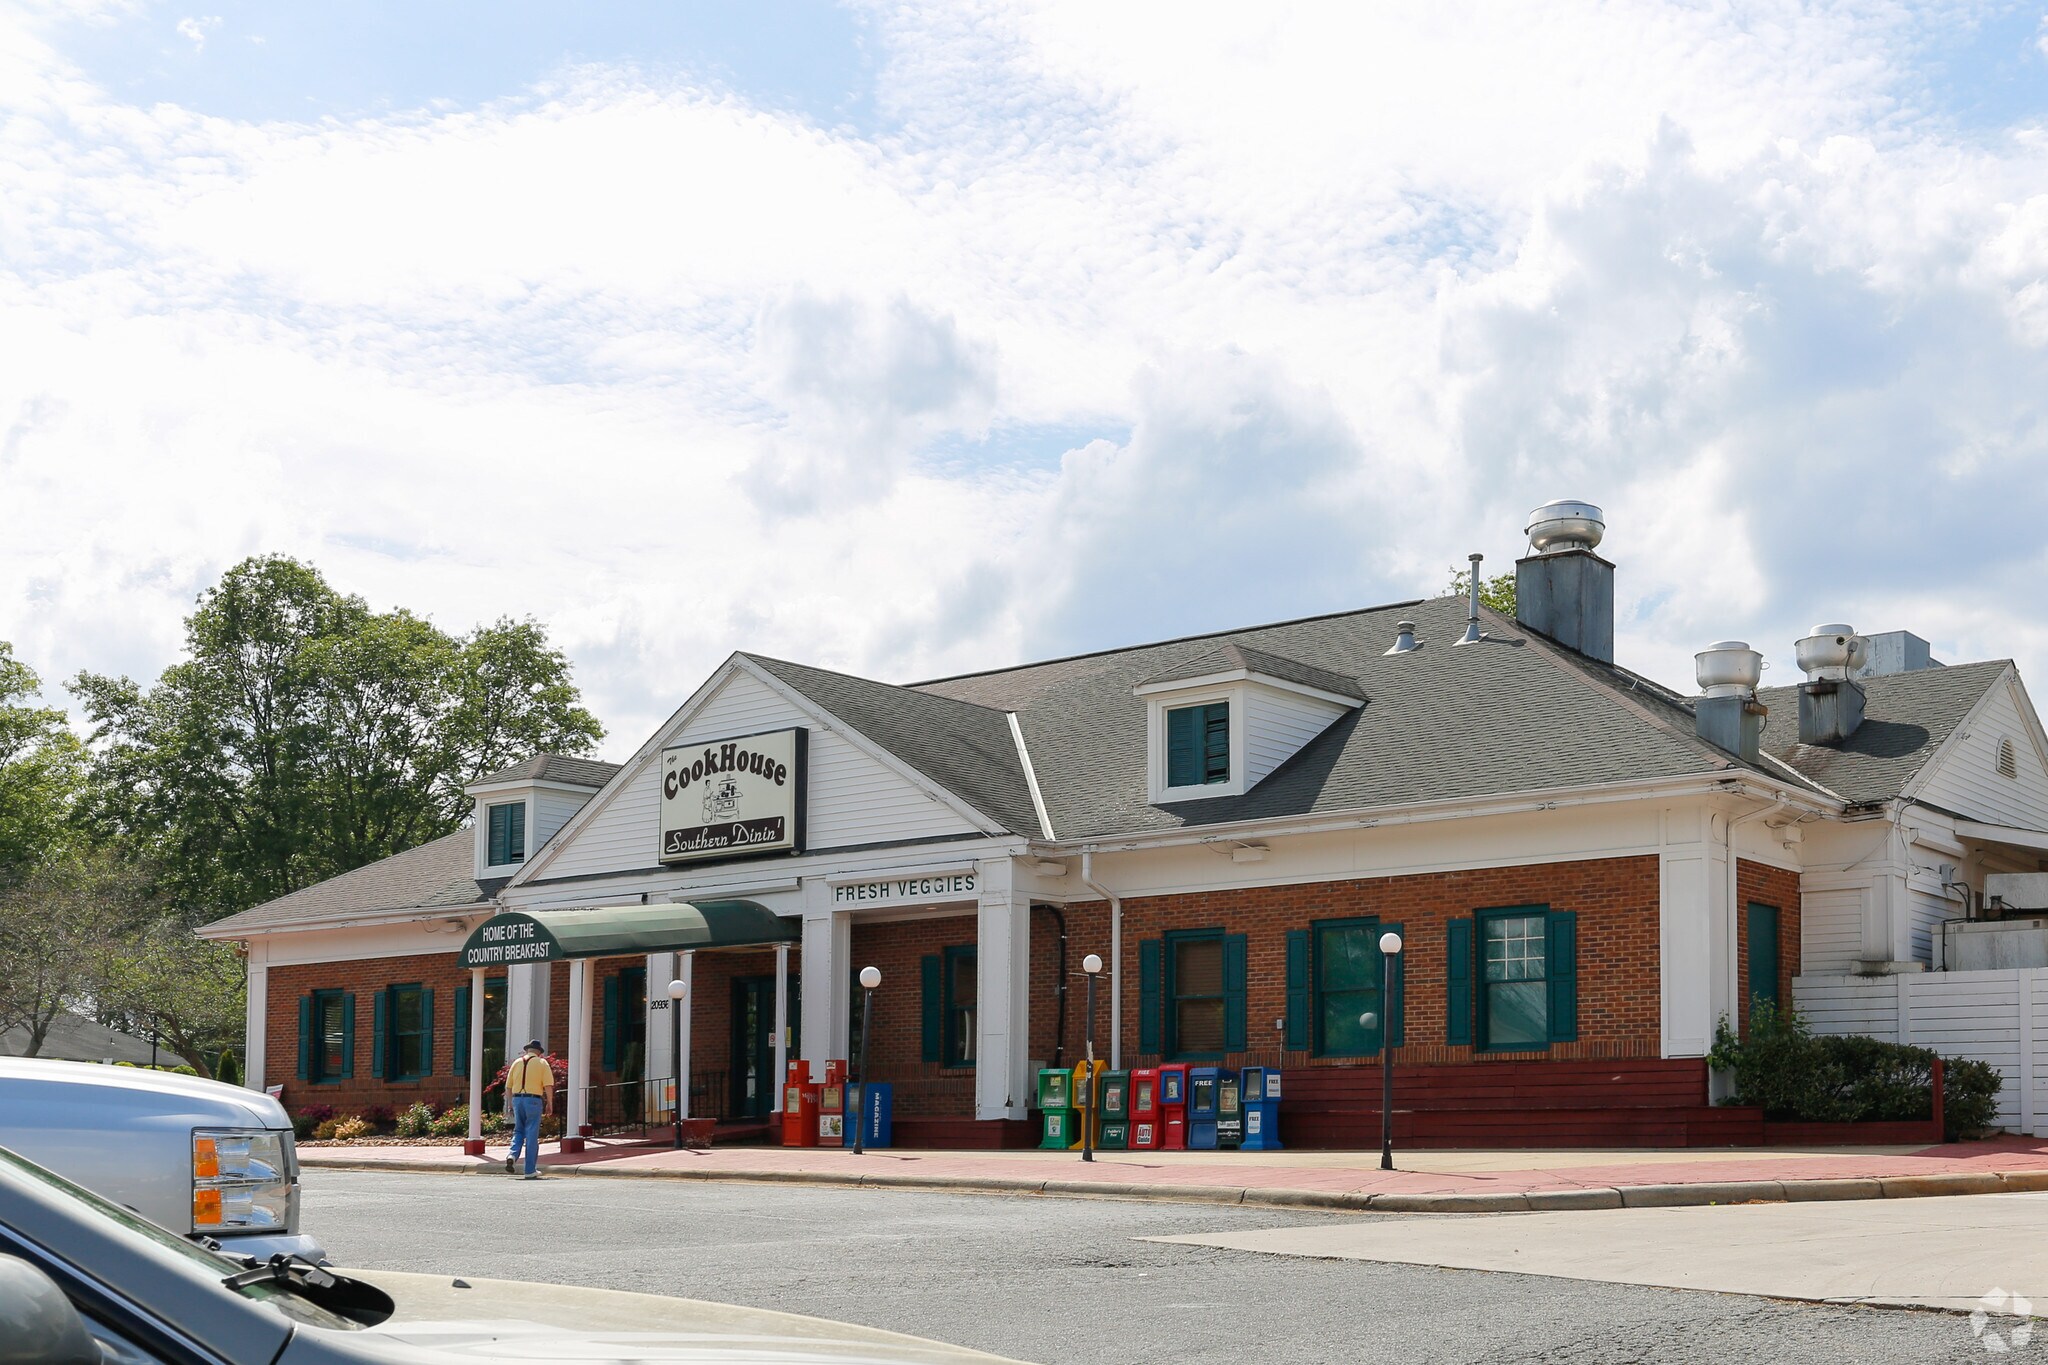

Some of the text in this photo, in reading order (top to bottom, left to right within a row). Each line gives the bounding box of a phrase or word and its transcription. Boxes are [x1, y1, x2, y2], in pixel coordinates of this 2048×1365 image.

[664, 743, 787, 800] CookHouse
[667, 755, 677, 765] The
[666, 827, 729, 853] Southern
[836, 875, 975, 902] FRESH VEGGIES
[482, 923, 534, 942] HOME OF THE
[467, 942, 550, 963] COUNTRY BREAKFAST
